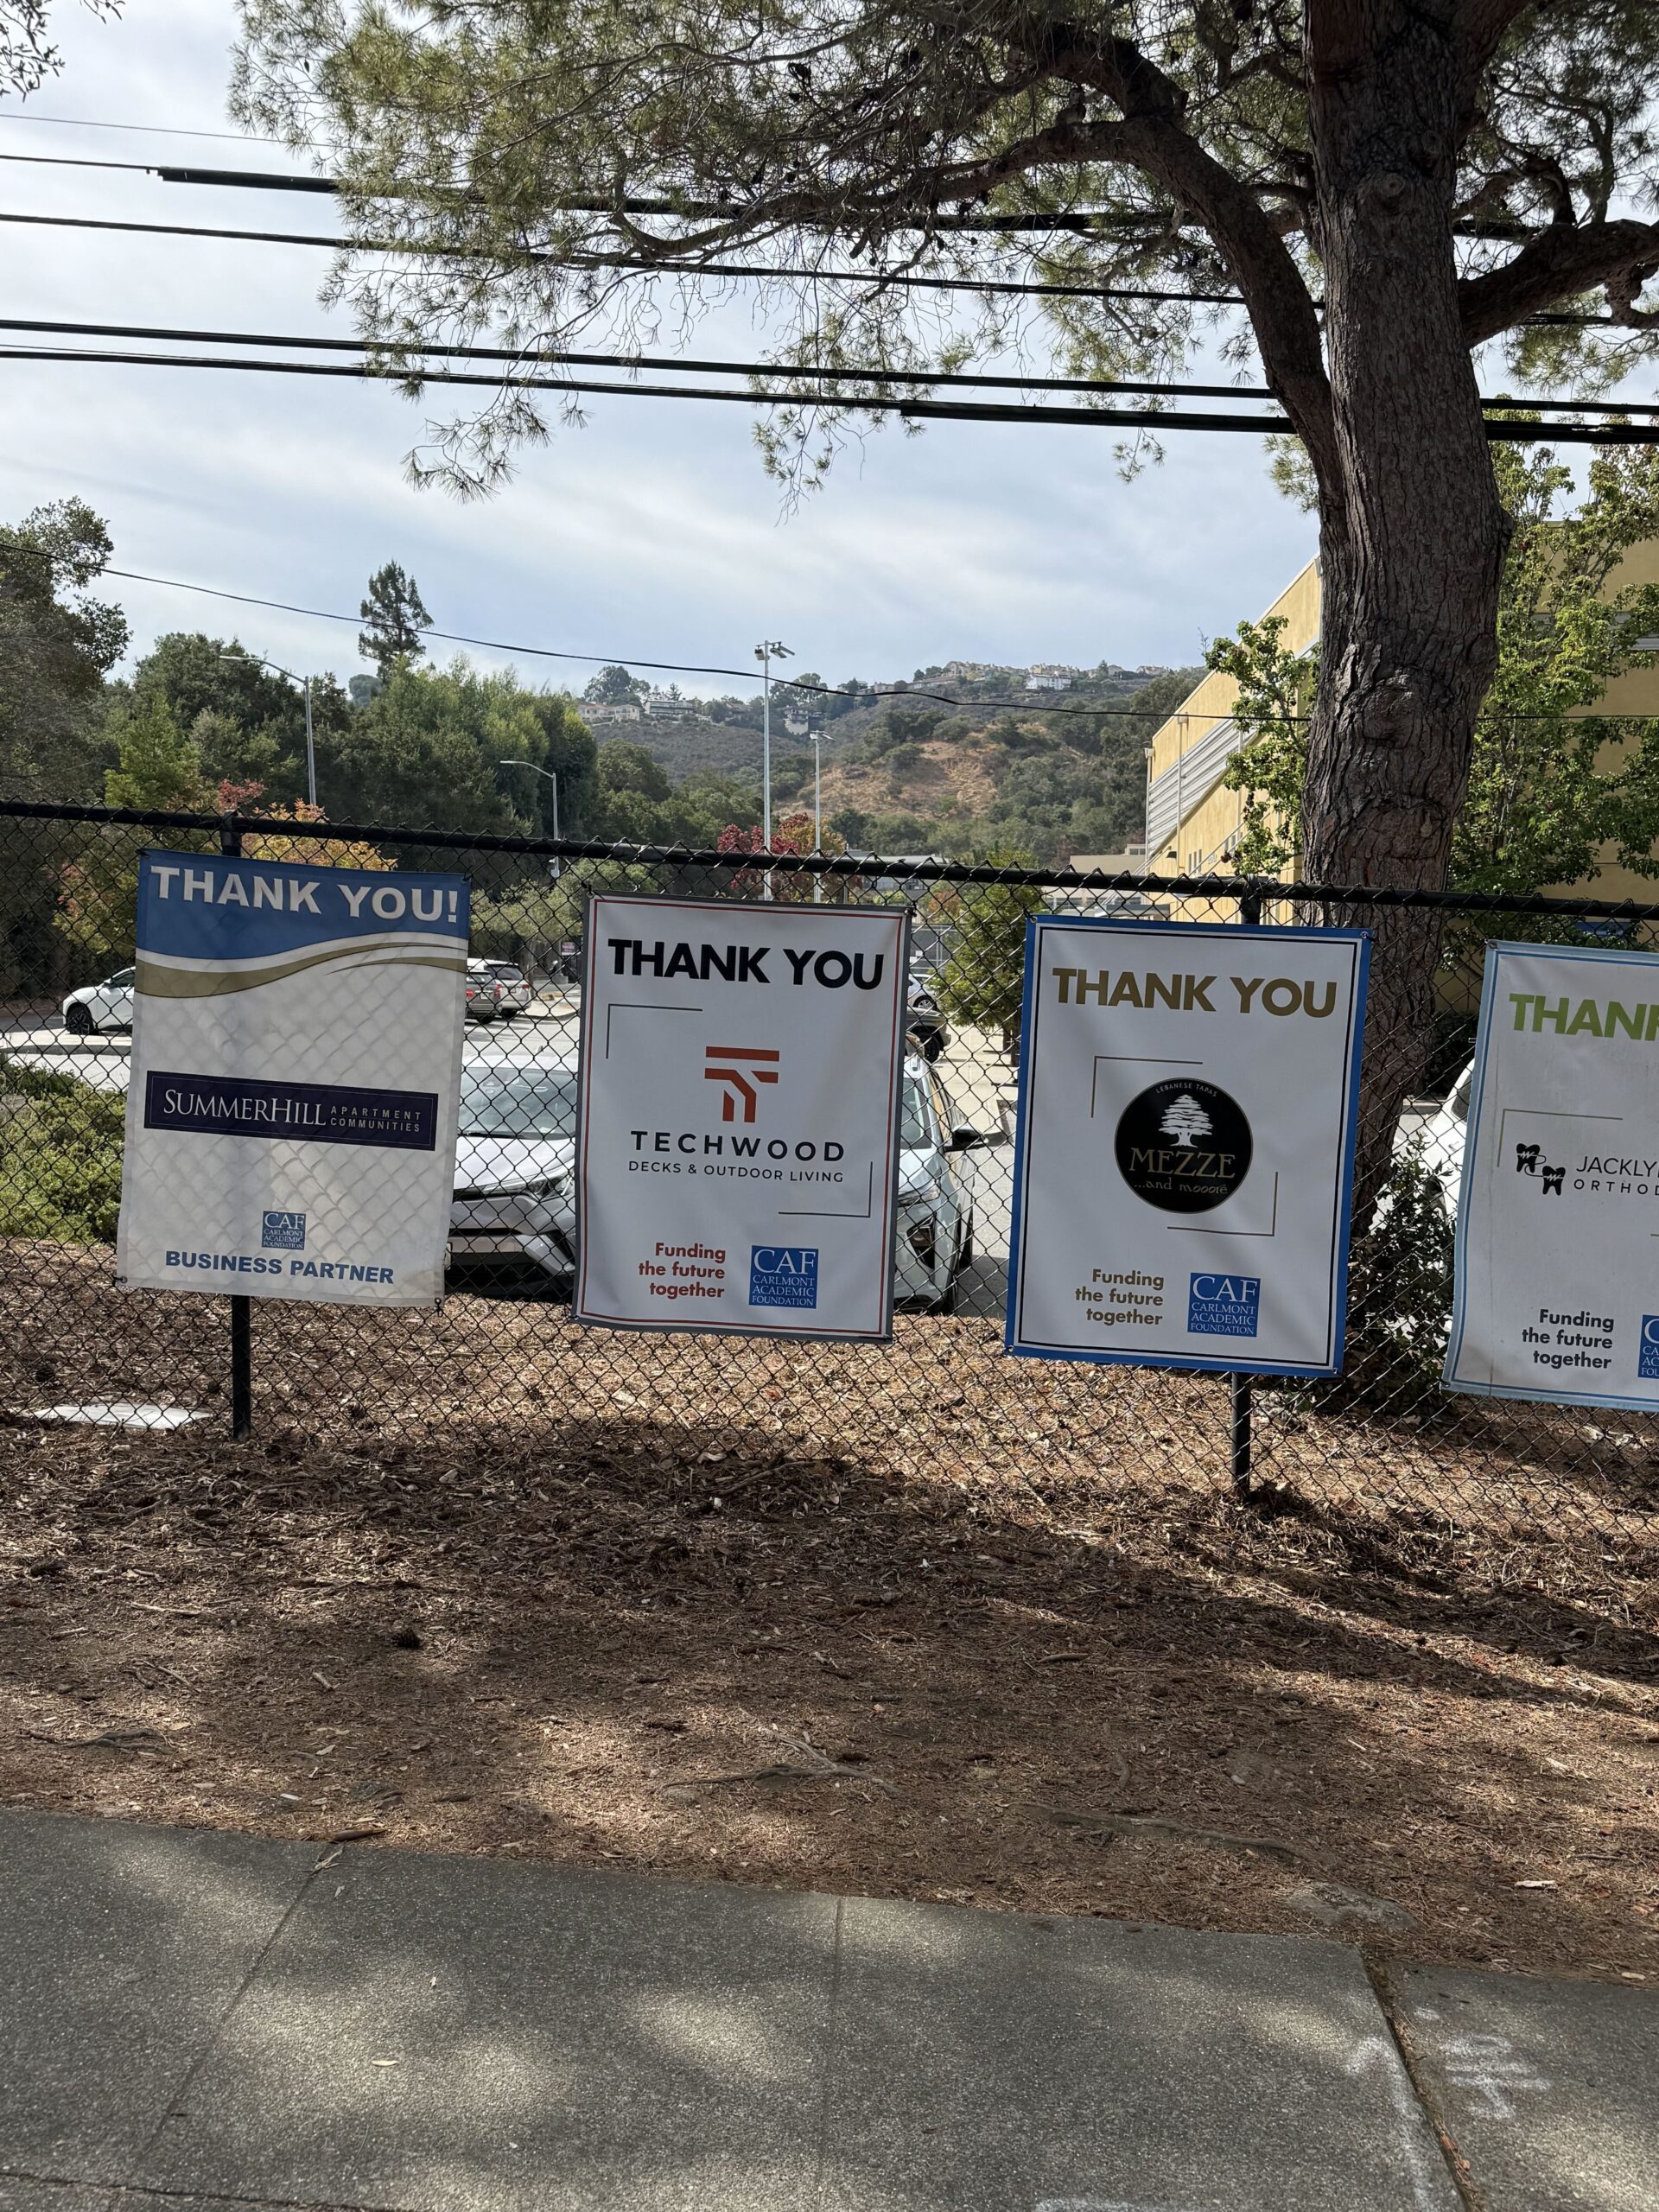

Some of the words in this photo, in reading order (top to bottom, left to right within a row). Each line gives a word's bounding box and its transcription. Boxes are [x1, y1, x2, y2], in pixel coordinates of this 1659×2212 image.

[150, 865, 321, 914] THANK
[337, 884, 459, 923] YOU!
[607, 938, 771, 984] THANK
[783, 949, 885, 990] YOU
[1052, 968, 1217, 1012] THANK
[1230, 976, 1338, 1018] YOU
[1156, 1083, 1192, 1094] LEBANESE
[1196, 1084, 1217, 1097] TAPAS
[331, 1105, 421, 1119] APARTMENT
[330, 1117, 421, 1133] COMMUNITIES
[631, 1130, 845, 1162] TECHWOOD
[628, 1160, 682, 1174] DECKS
[688, 1164, 697, 1175] &
[704, 1164, 783, 1180] OUTDOOR
[790, 1170, 844, 1183] LIVING
[1128, 1147, 1236, 1179] MEZZE
[1576, 1155, 1659, 1178] JACKLY
[264, 1213, 305, 1229] CAF
[655, 1242, 727, 1264] Funding
[753, 1249, 816, 1274] CAF
[165, 1250, 282, 1274] BUSINESS
[289, 1261, 394, 1284] PARTNER
[639, 1262, 667, 1276] the
[671, 1262, 725, 1279] future
[753, 1274, 815, 1287] CARLMONT
[1092, 1268, 1164, 1291] Funding
[1192, 1275, 1258, 1303] CAF
[650, 1281, 725, 1299] together
[753, 1285, 815, 1297] ACADEMIC
[1075, 1287, 1104, 1303] the
[1109, 1289, 1163, 1306] future
[752, 1295, 814, 1306] FOUNDATION
[1191, 1302, 1255, 1315] CARLMONT
[1086, 1307, 1162, 1325] together
[1191, 1313, 1255, 1325] ACADEMIC
[1539, 1308, 1614, 1332] Funding
[1191, 1323, 1255, 1335] FOUNDATION
[1522, 1329, 1550, 1344] the
[1556, 1330, 1612, 1349] future
[1533, 1350, 1611, 1370] together
